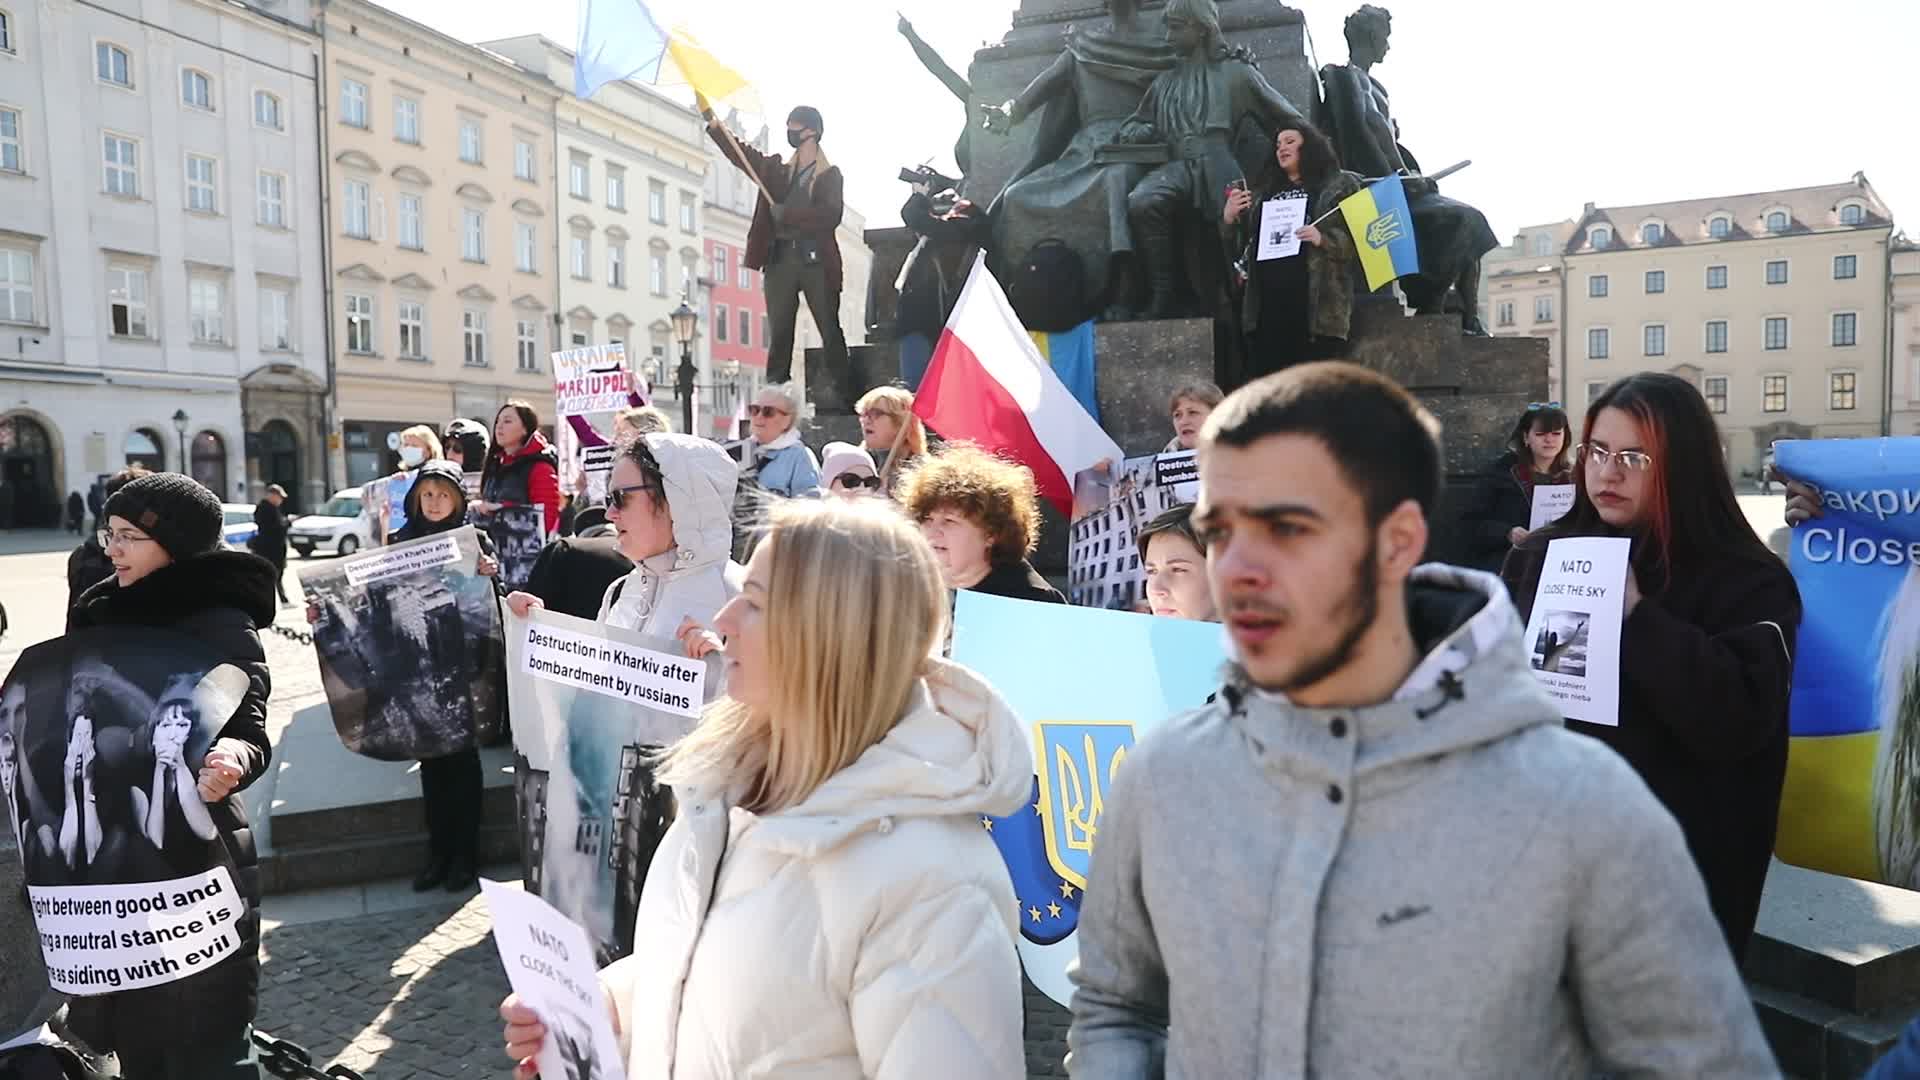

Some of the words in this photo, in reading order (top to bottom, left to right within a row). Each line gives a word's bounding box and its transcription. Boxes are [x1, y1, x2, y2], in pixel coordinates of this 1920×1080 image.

[560, 344, 624, 367] UKRAINE
[556, 374, 626, 399] MARIUPOL
[348, 556, 395, 573] Destruction
[395, 553, 404, 561] in
[404, 547, 434, 559] Kharkiv
[435, 542, 454, 552] after
[355, 563, 411, 580] bombardment
[411, 561, 422, 570] by
[1560, 560, 1592, 574] NATO
[1544, 584, 1566, 594] CLOSE
[1567, 584, 1584, 596] THE
[1586, 586, 1607, 598] SKY
[528, 629, 596, 659] Destruction
[599, 645, 611, 662] in
[613, 650, 661, 675] Kharkiv
[661, 663, 699, 684] after
[529, 654, 614, 689] bombardment
[616, 675, 633, 696] by
[634, 682, 690, 709] russians
[53, 897, 112, 916] between
[116, 892, 168, 919] good
[172, 879, 223, 907] and
[55, 934, 61, 950] a
[63, 931, 117, 950] neutral
[122, 918, 204, 948] stance
[208, 905, 232, 926] is
[528, 924, 569, 962] NATO
[68, 964, 121, 987] siding
[124, 956, 180, 982] with
[185, 934, 231, 967] evil
